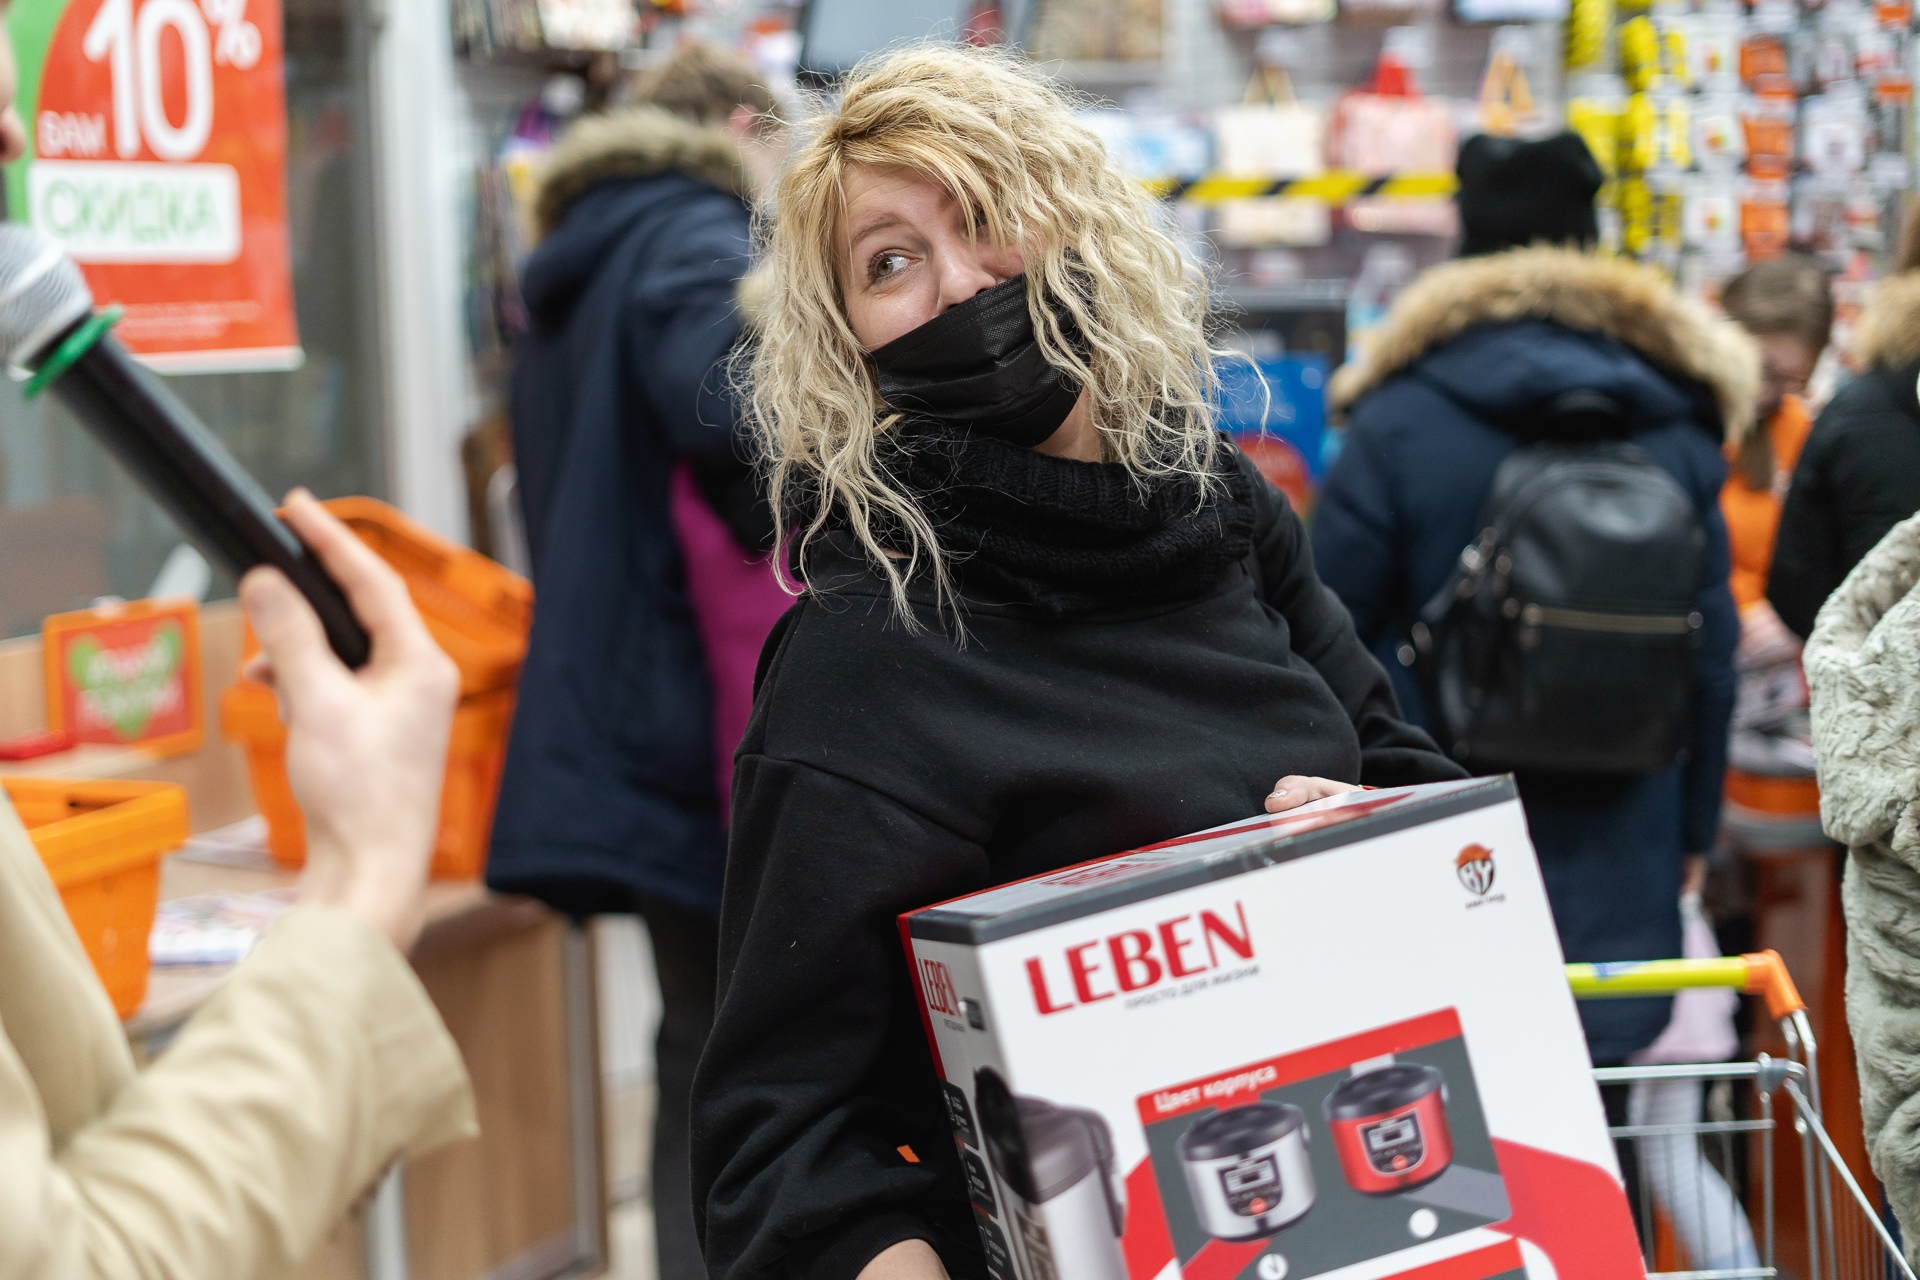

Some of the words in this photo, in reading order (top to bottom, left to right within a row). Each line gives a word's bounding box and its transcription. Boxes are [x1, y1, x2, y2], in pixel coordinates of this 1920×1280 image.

[42, 178, 222, 244] СКИДКА
[918, 957, 963, 1018] LEBEN
[1025, 899, 1254, 1016] LEBEN
[1153, 1086, 1200, 1114] Цвет
[1203, 1065, 1278, 1098] корпуса
